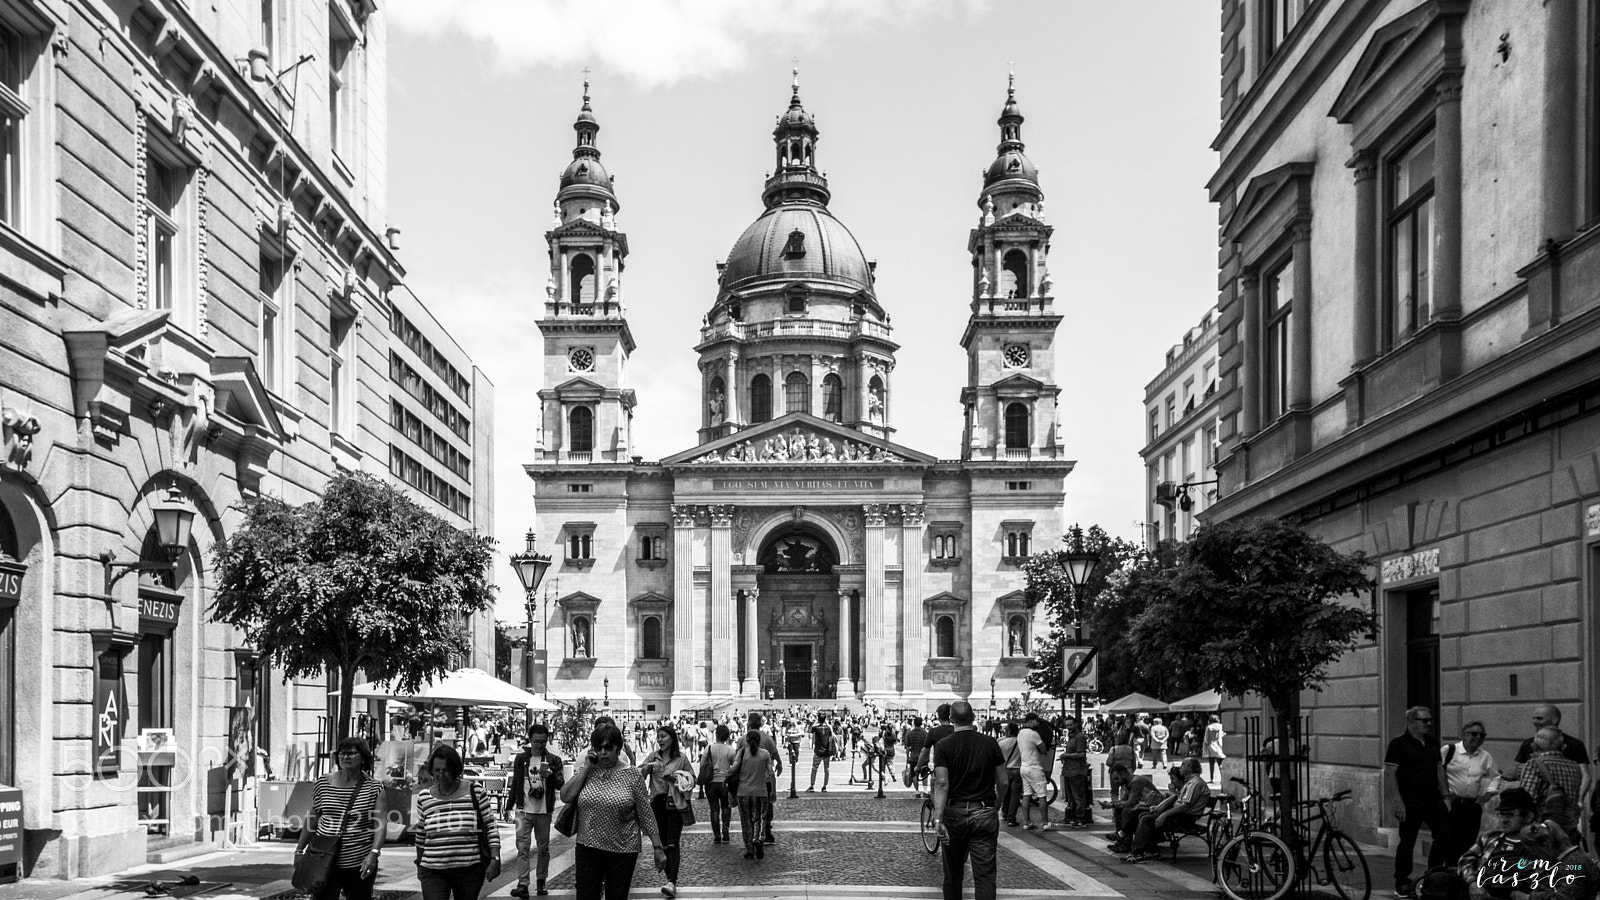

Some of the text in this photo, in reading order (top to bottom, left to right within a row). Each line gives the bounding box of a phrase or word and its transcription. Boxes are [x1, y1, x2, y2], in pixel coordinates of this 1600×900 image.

[723, 481, 874, 489] EGO SUM VIA VERITAS ET VITA
[0, 801, 21, 812] PING
[3, 818, 19, 829] EUR
